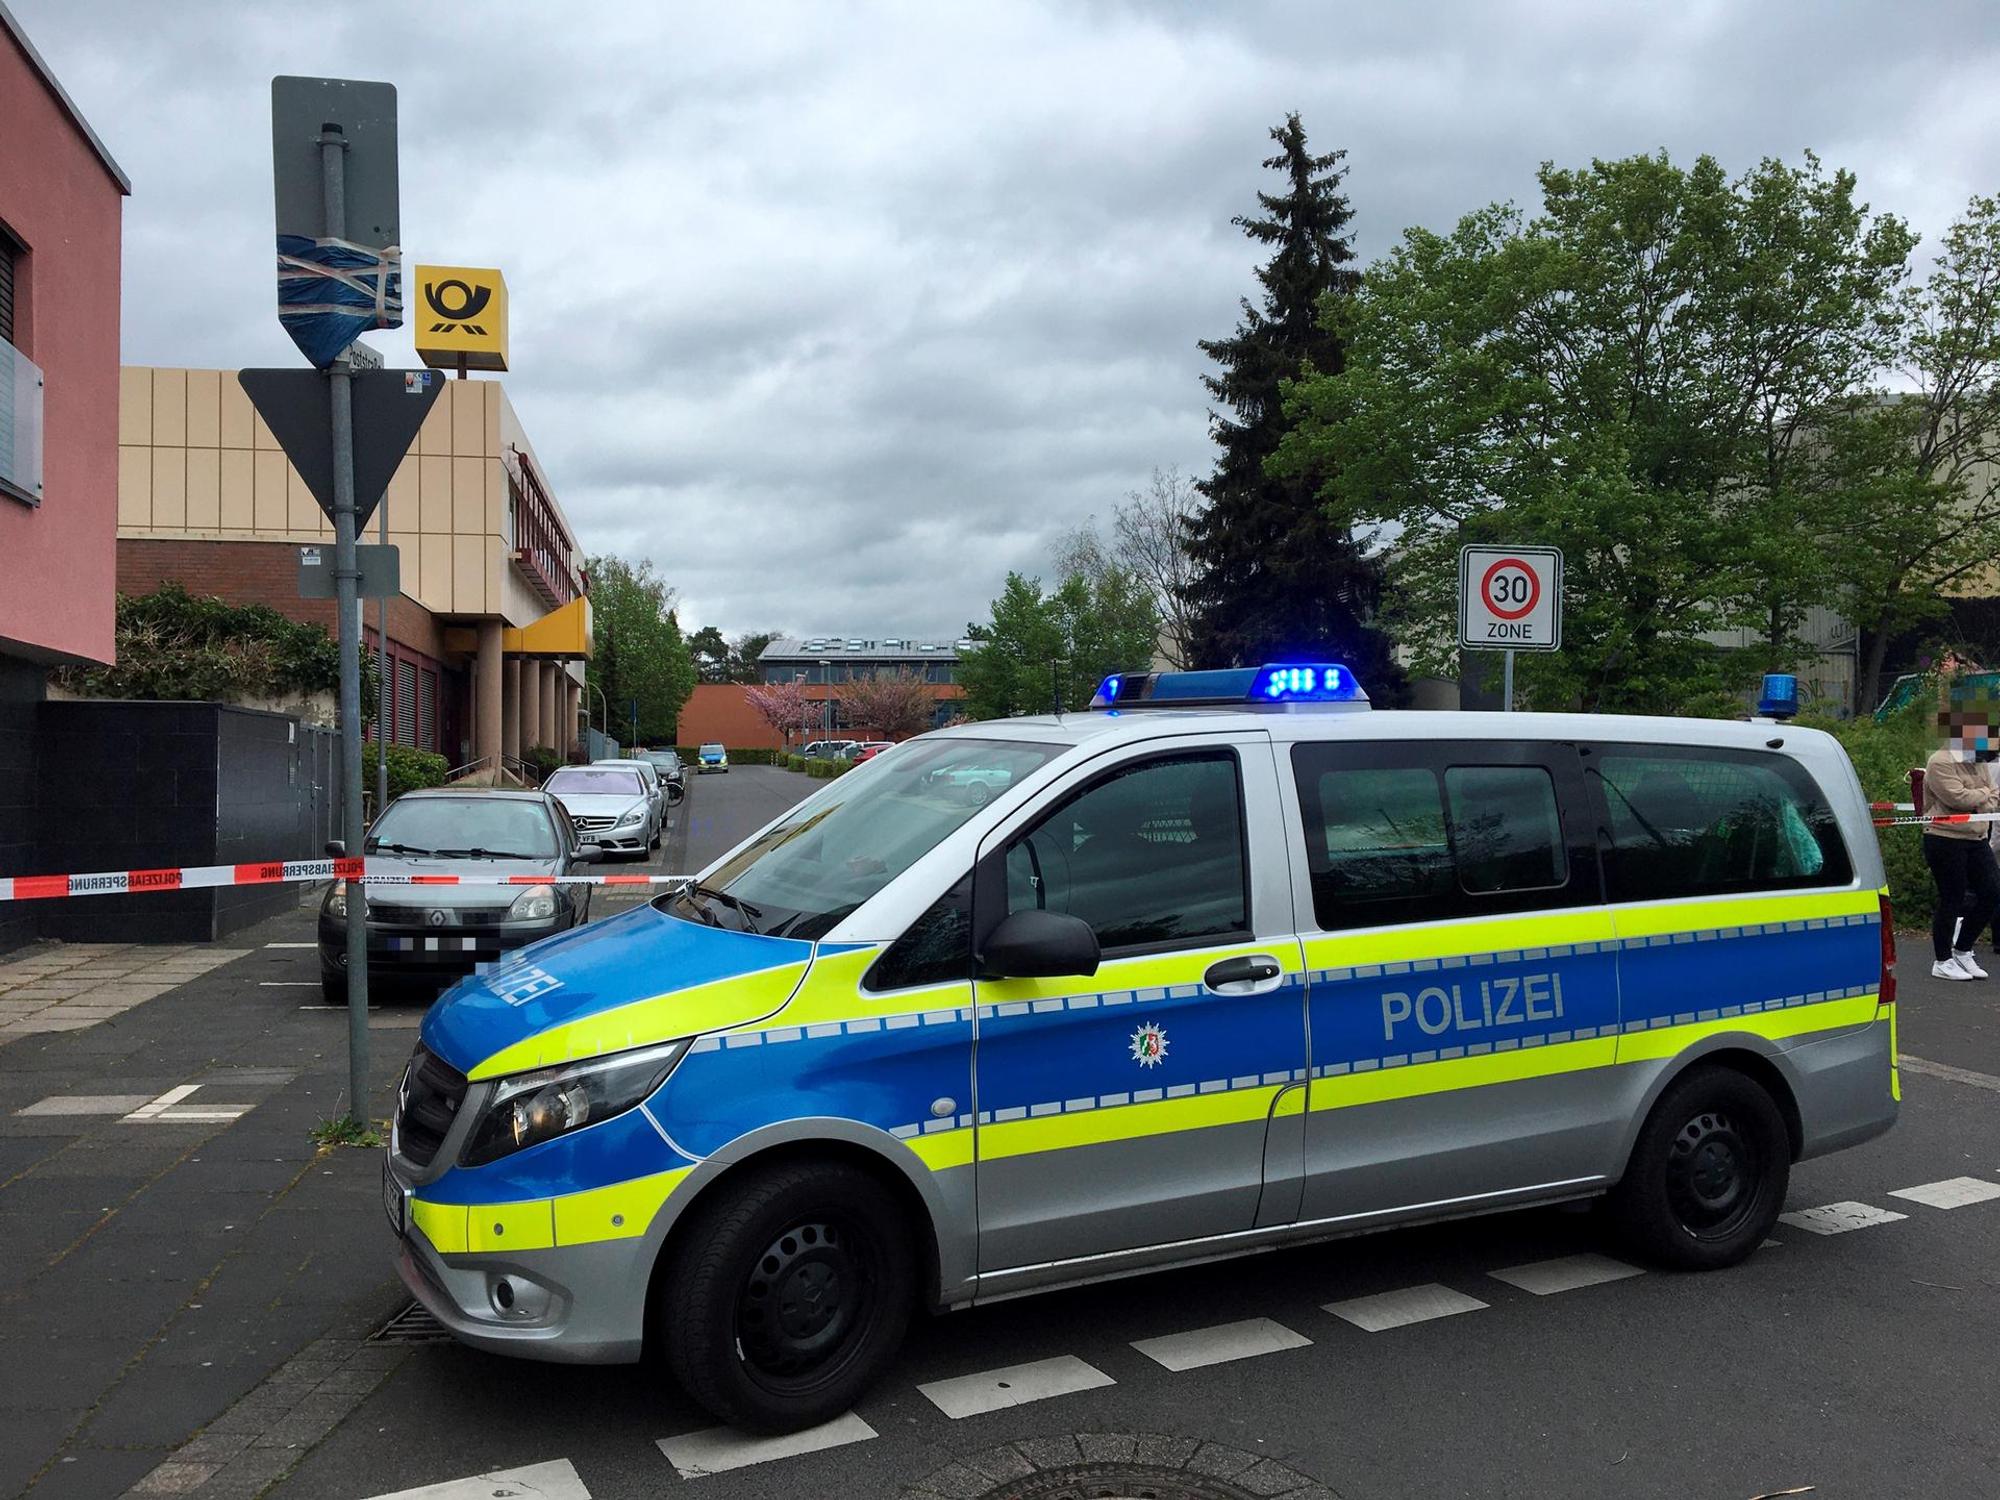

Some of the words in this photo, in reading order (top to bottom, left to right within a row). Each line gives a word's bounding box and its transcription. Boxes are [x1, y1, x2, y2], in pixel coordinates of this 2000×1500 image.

[1493, 575, 1528, 603] 30
[1487, 623, 1533, 639] ZONE
[1381, 972, 1564, 1041] POLIZEI
